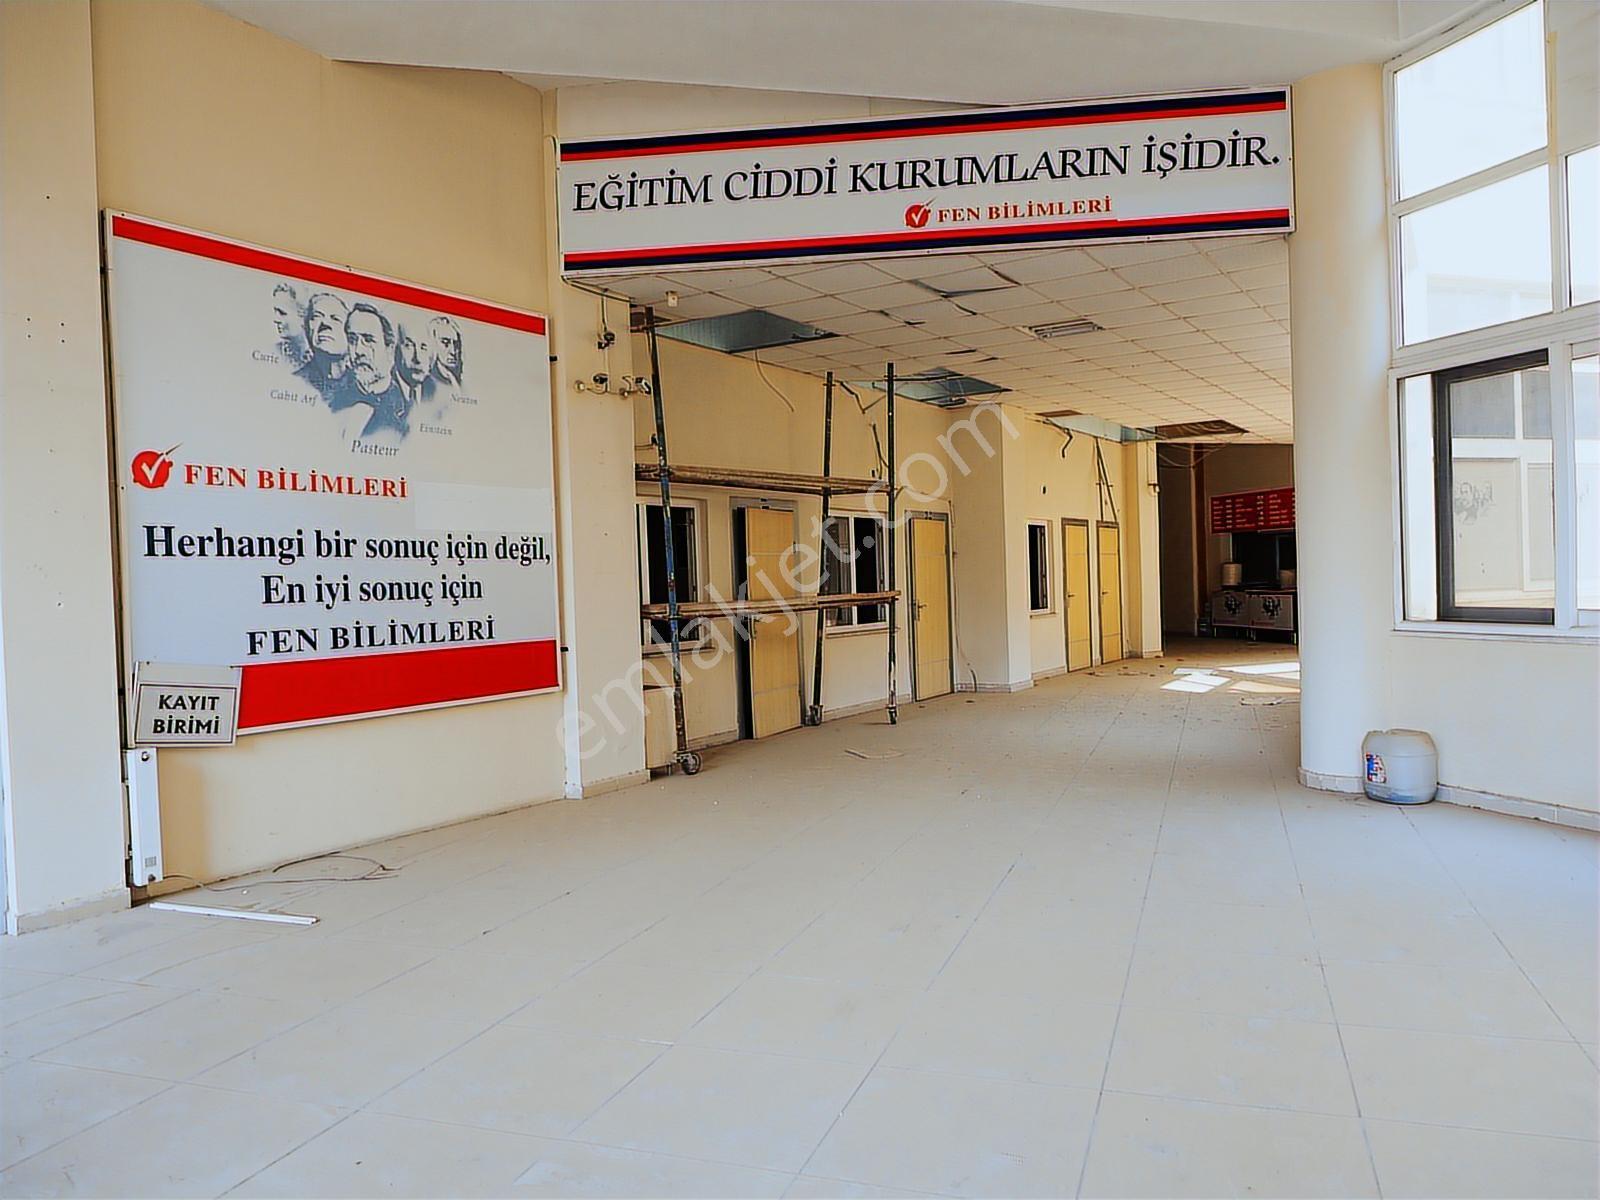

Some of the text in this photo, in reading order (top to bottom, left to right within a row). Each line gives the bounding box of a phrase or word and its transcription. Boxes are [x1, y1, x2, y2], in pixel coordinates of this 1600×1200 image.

[572, 129, 1281, 211] EĞİTİM CİDDİ KURUMLARIN İŞİDİR.
[937, 195, 1112, 223] FEN BİLİMLERİ
[351, 439, 400, 457] Pasteur
[185, 463, 409, 498] FEN BİLİMLERİ
[143, 525, 551, 565] Herhangi bir sonuç için değil,
[261, 572, 483, 609] En iyi sonuç için
[246, 616, 496, 655] FEN BİLİMLERİ
[158, 694, 220, 711] KAYIT
[152, 714, 220, 734] BİRİMİ
